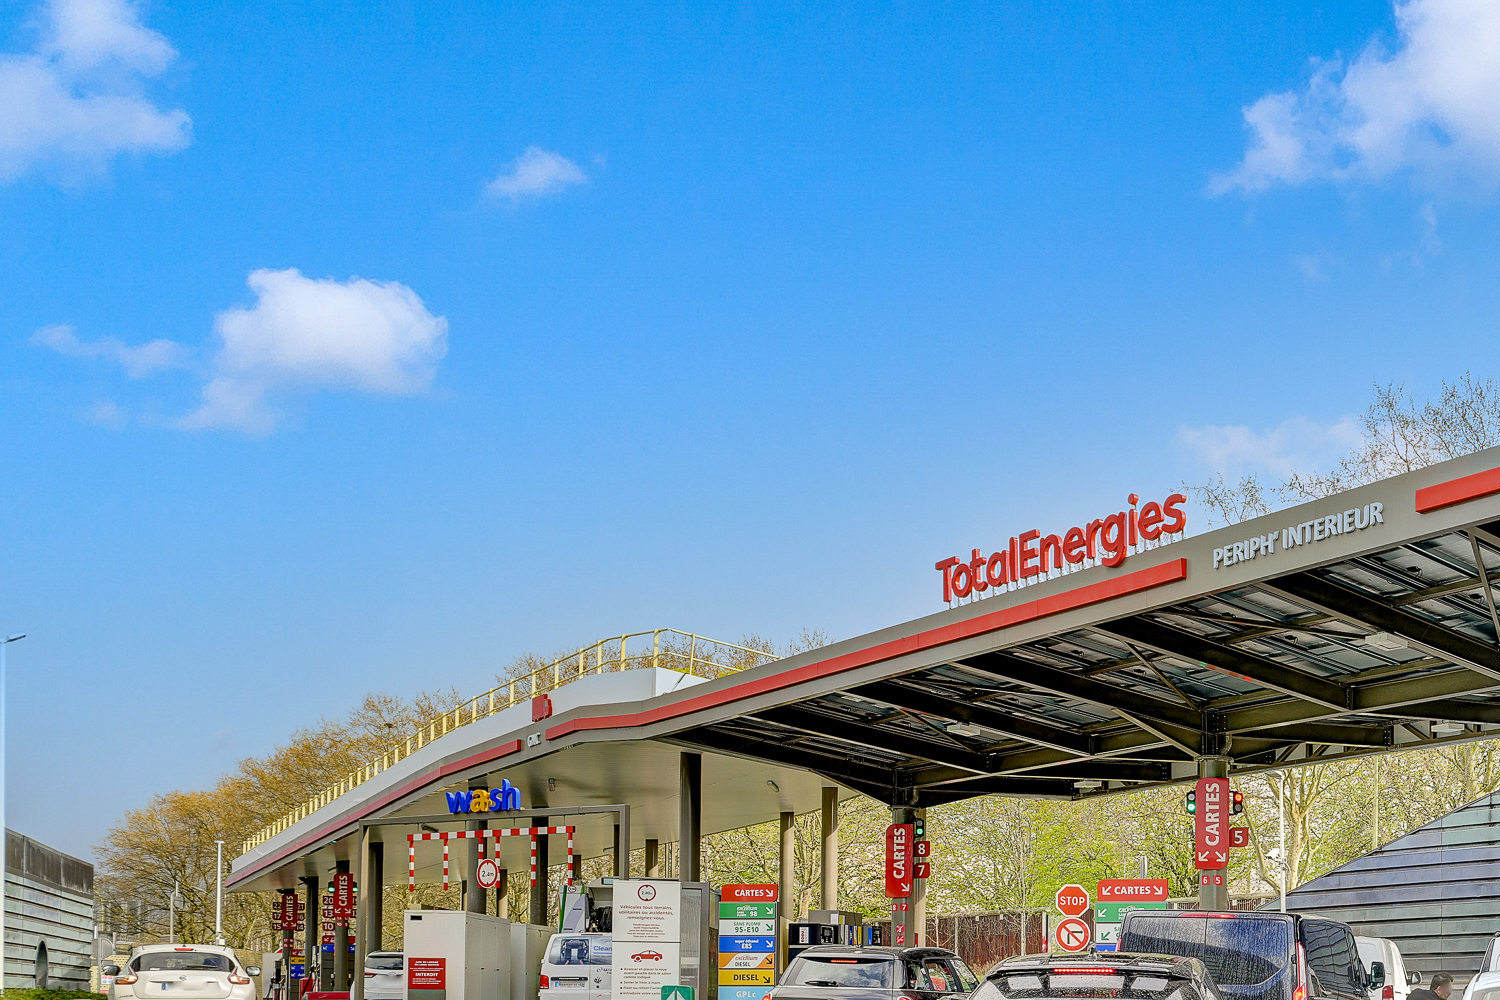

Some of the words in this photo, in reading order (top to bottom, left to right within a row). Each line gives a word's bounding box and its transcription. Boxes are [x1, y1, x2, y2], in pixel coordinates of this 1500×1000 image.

[1213, 531, 1280, 569] PERIPH'
[1283, 502, 1384, 550] INTERIEUR
[935, 493, 1187, 602] TotalEnergies
[445, 778, 521, 814] wash
[1205, 783, 1220, 846] CARTES
[1234, 830, 1244, 845] 5
[893, 828, 906, 879] CARTES
[918, 843, 926, 855] 8
[918, 864, 926, 876] 7
[1202, 876, 1208, 884] 6
[1216, 876, 1221, 884] 5
[338, 875, 348, 906] CARTES
[734, 889, 765, 897] CARTES
[1114, 886, 1151, 894] CARTES
[323, 896, 334, 905] 20
[1060, 896, 1085, 906] STOP
[285, 895, 294, 921] CARTES
[323, 909, 334, 918] 13
[323, 922, 334, 931] 10
[736, 990, 757, 998] GPLc
